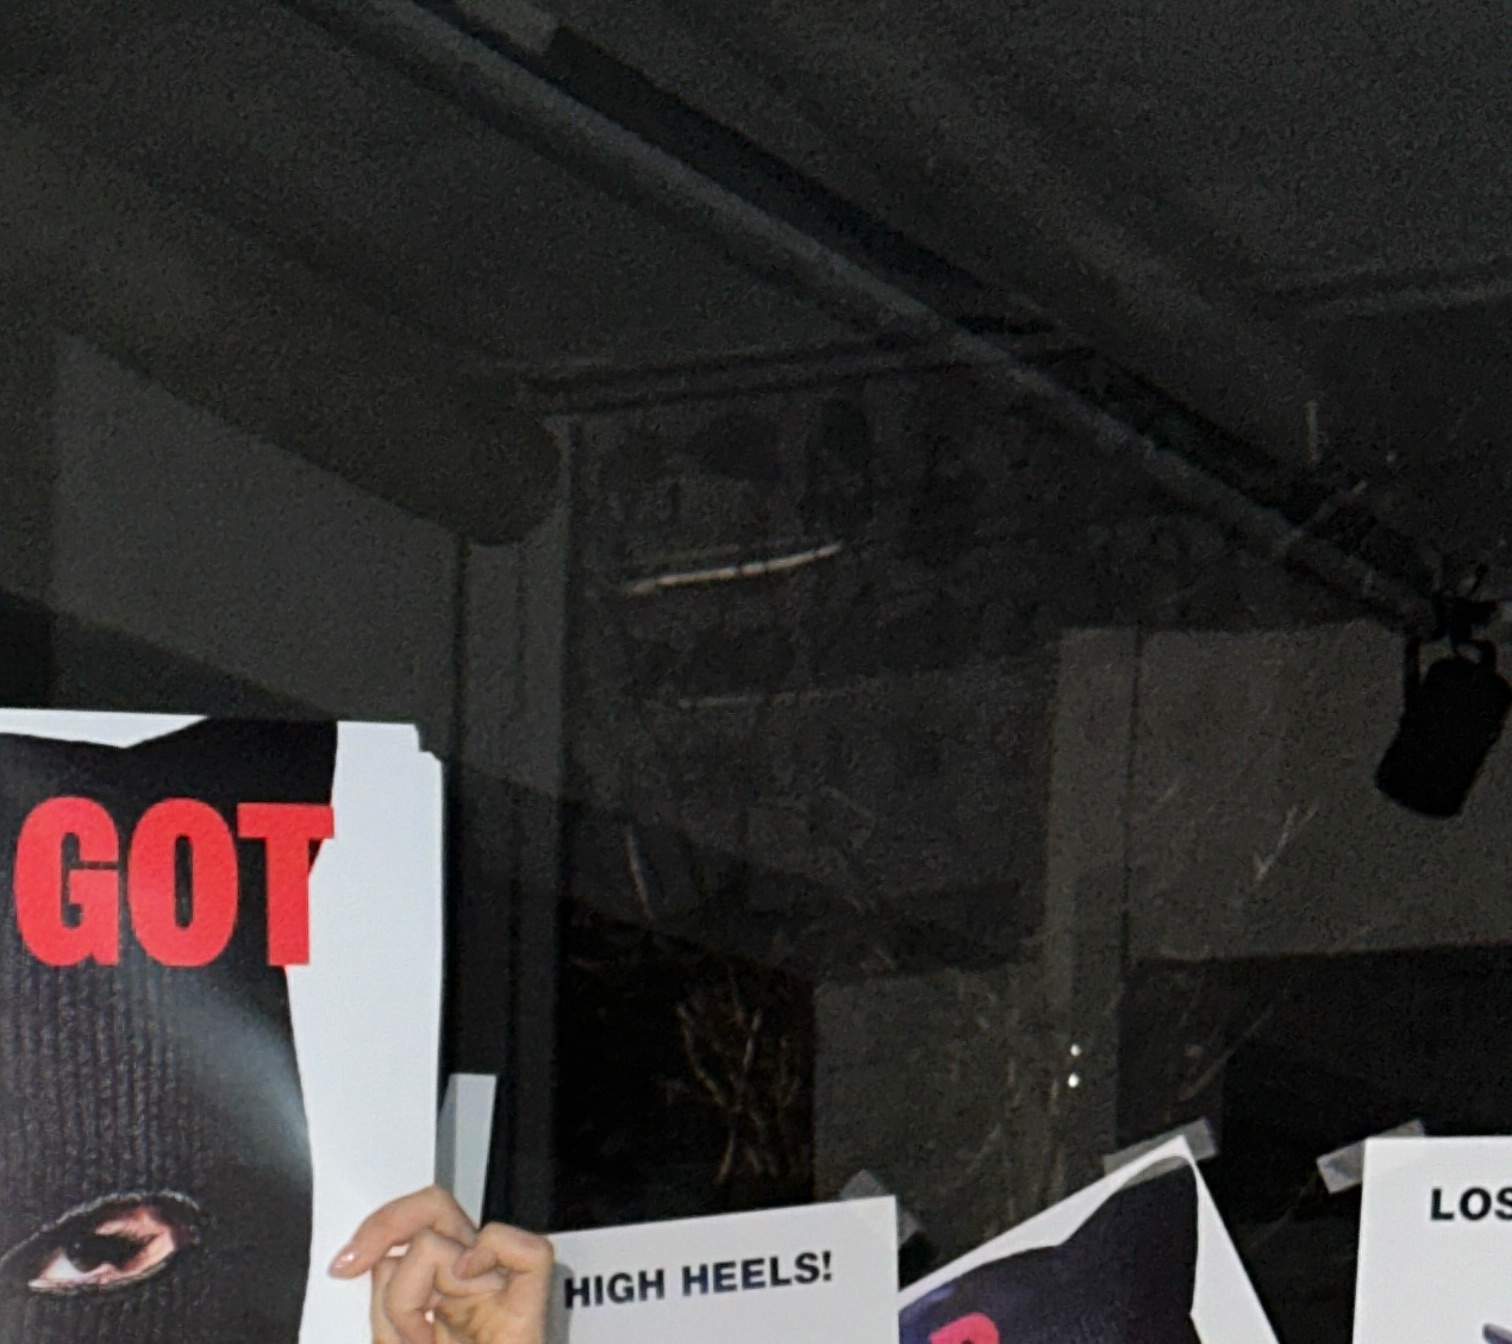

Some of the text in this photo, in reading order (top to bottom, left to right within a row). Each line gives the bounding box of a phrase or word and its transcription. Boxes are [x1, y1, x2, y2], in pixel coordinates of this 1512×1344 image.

[14, 797, 335, 967] GOT
[564, 1251, 833, 1309] HIGH HEELS!
